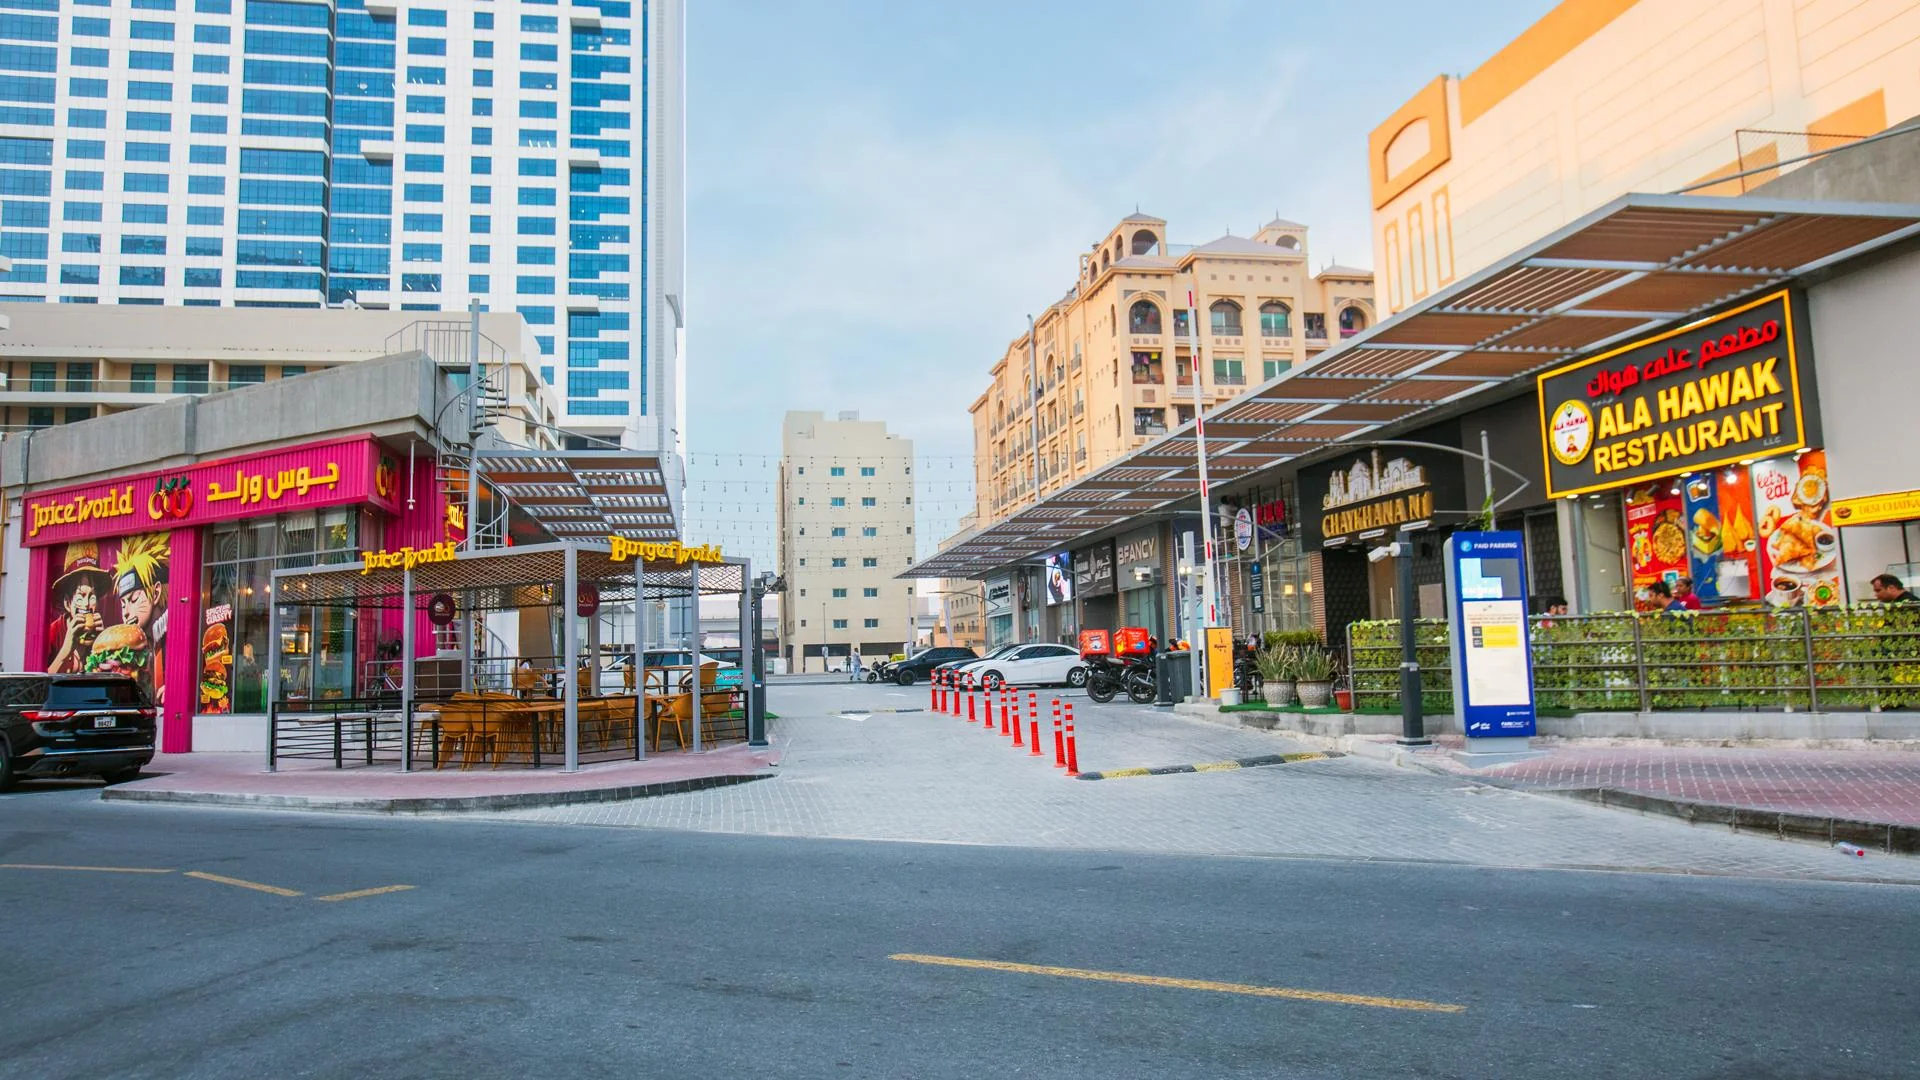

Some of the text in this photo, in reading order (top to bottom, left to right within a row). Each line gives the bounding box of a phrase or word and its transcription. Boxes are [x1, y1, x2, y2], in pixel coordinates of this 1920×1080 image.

[1698, 319, 1779, 369] مطعم
[1598, 357, 1784, 440] ALA HAWAK
[1593, 402, 1784, 475] RESTAURANT
[207, 462, 339, 505] جوس ورلد
[1118, 537, 1156, 565] BFANCY
